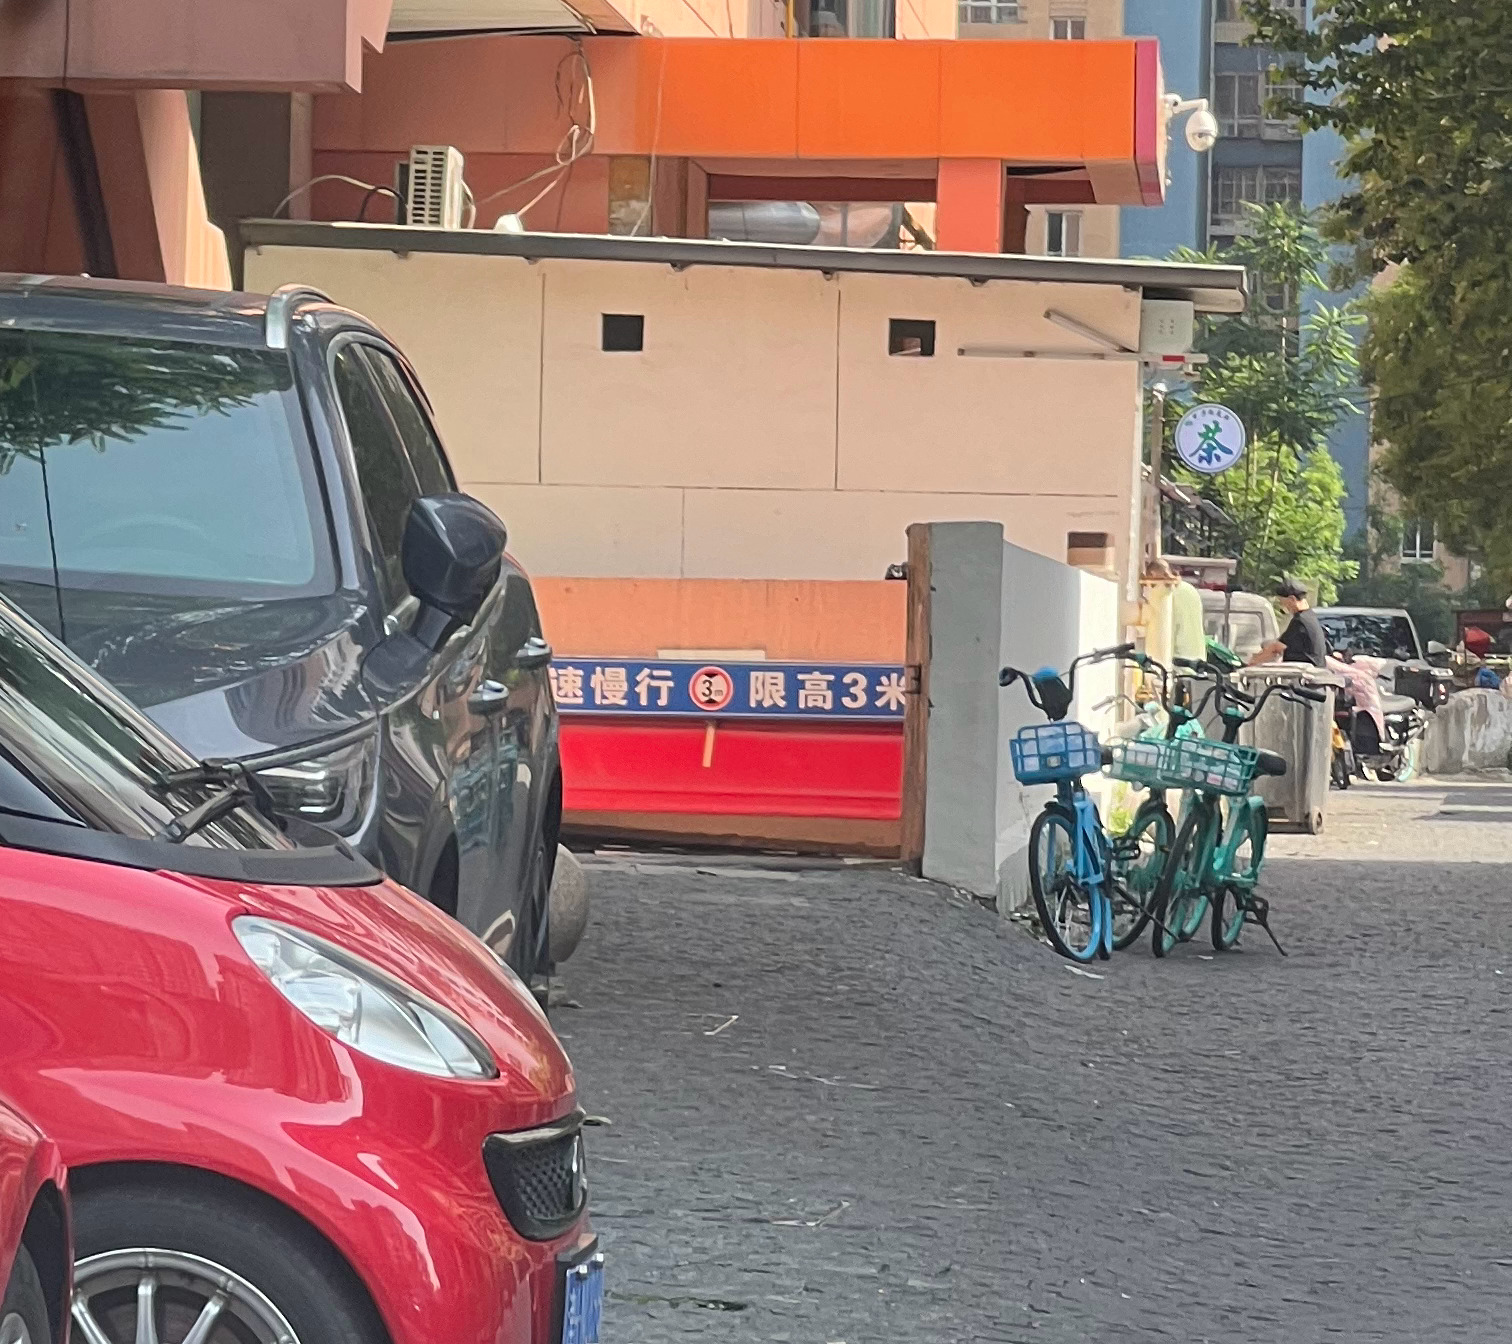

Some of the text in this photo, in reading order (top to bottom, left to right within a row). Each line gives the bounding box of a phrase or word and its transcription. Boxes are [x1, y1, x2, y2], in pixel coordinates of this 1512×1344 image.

[1188, 419, 1235, 466] 茶
[548, 665, 674, 707] 速慢行
[748, 670, 906, 711] 限高3米
